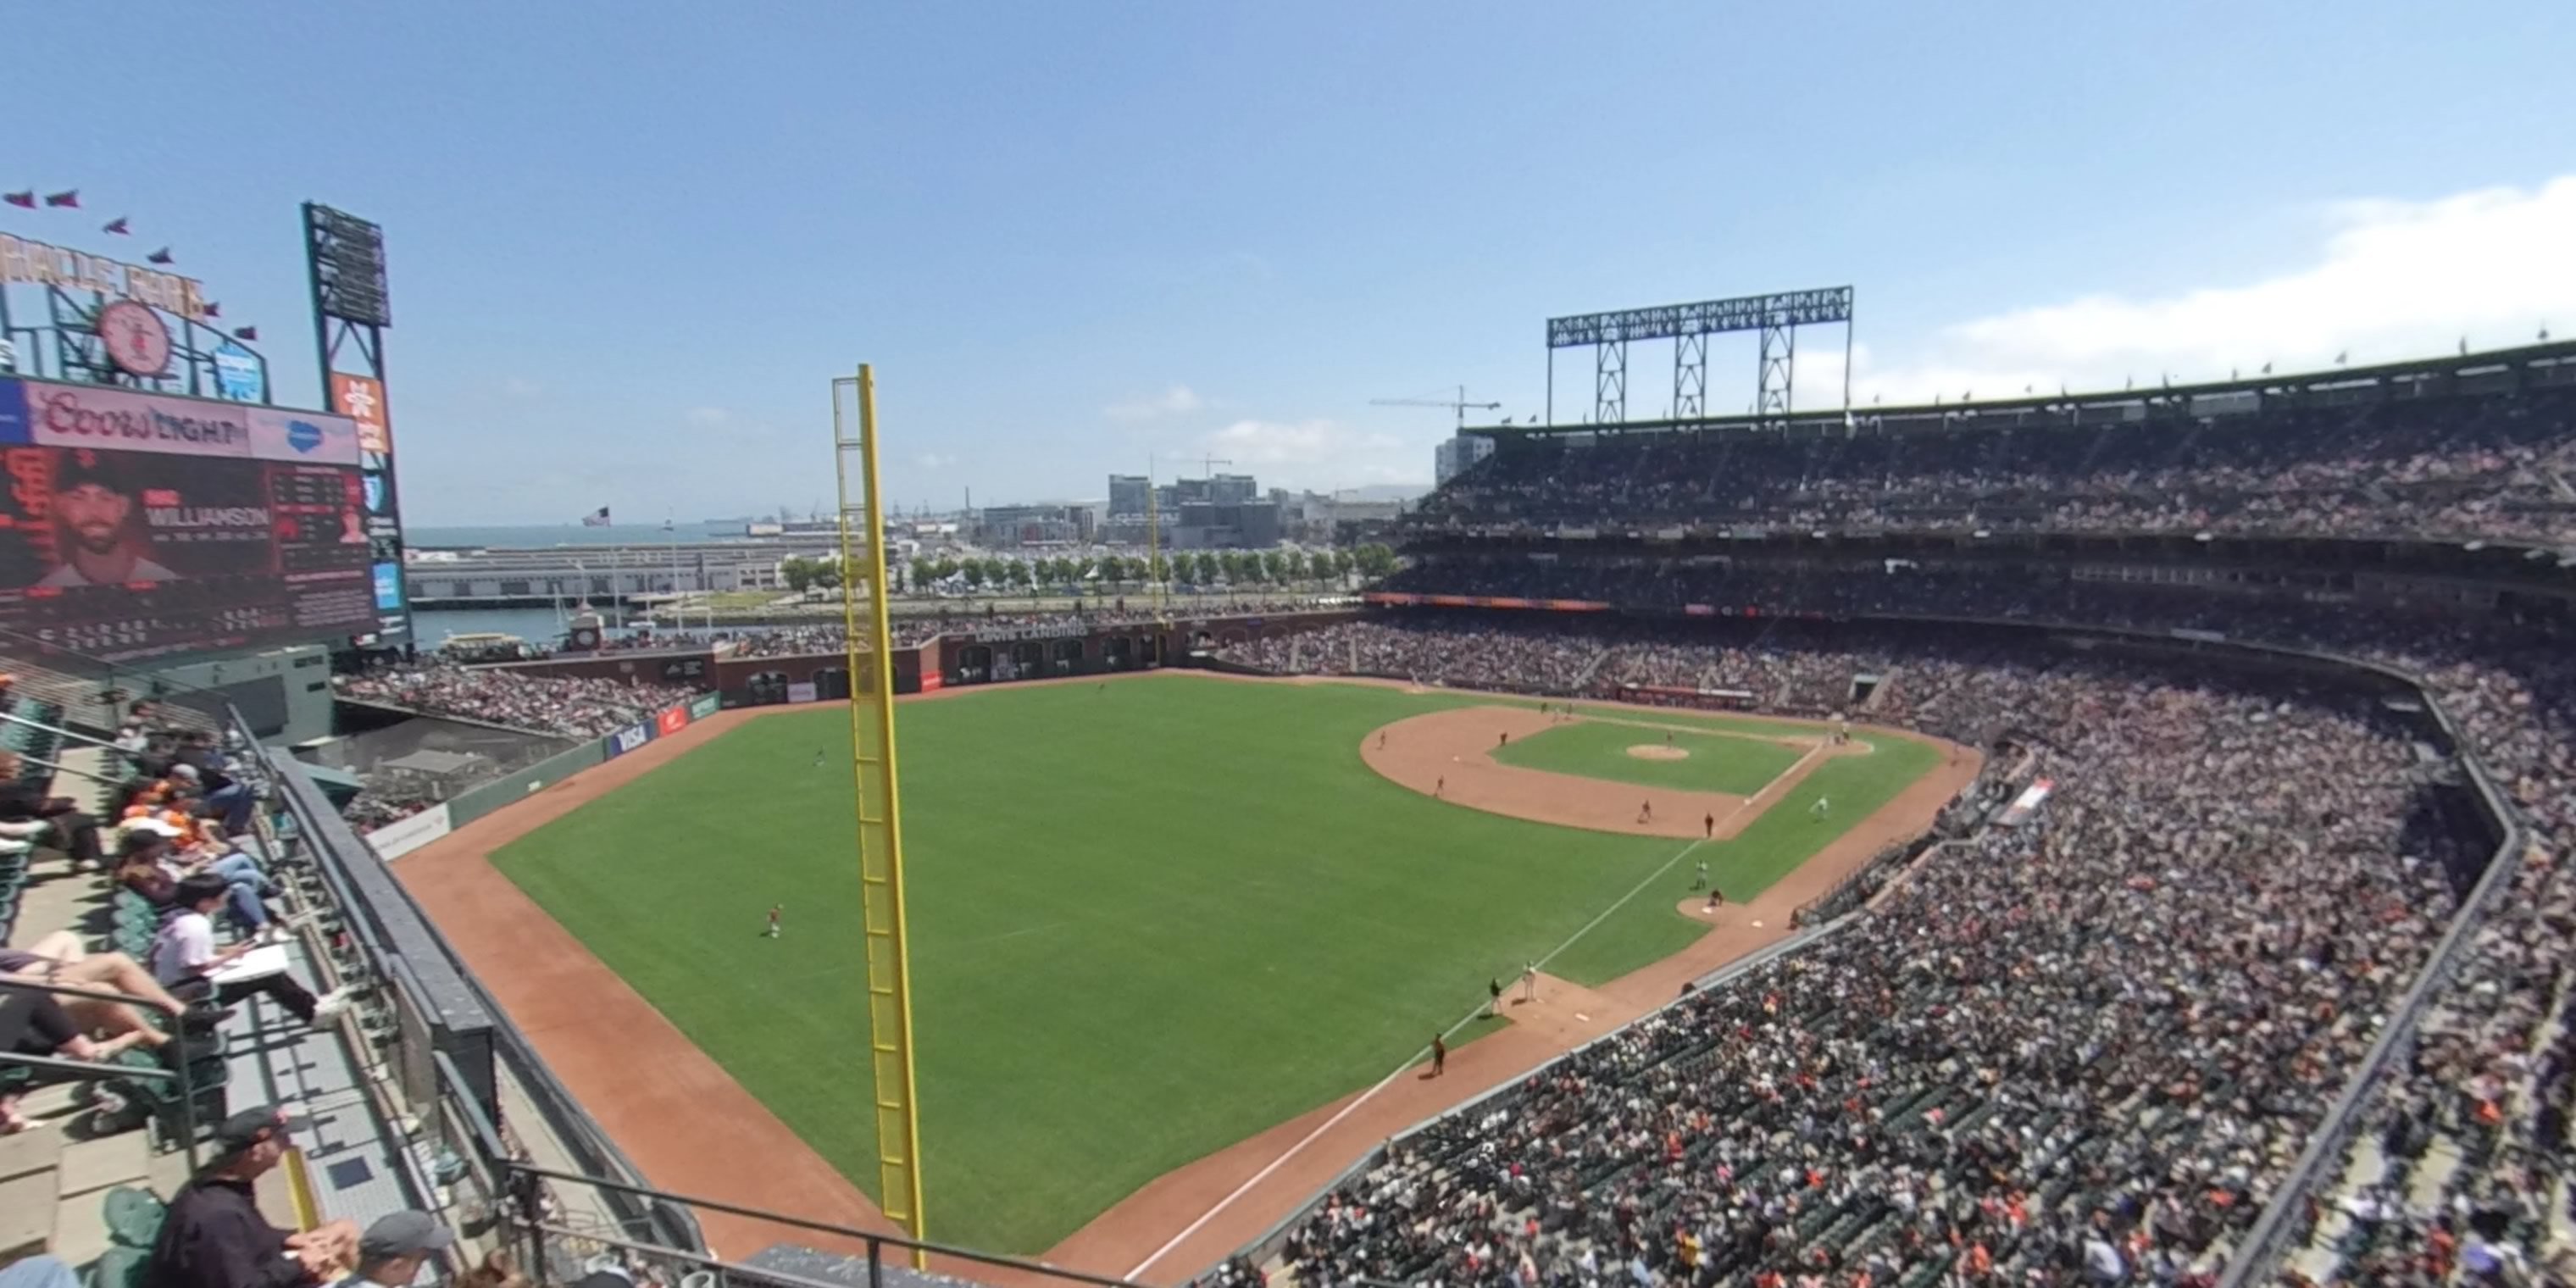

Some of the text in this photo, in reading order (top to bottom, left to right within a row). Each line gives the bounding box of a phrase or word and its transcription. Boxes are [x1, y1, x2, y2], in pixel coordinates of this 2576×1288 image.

[40, 391, 151, 439] Coors
[145, 507, 269, 526] WILLIAMSON
[617, 725, 647, 752] VISA
